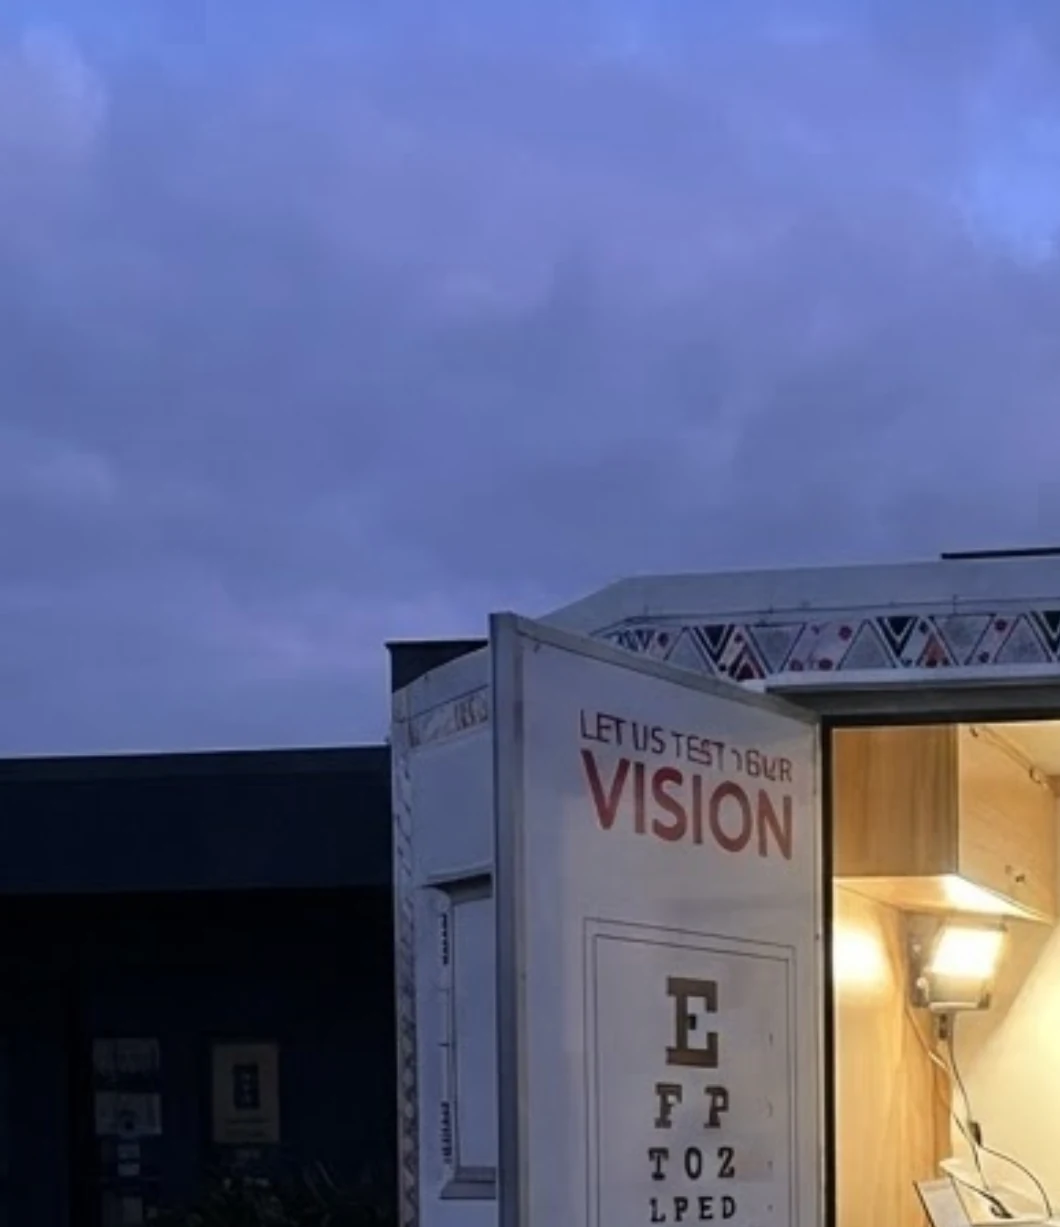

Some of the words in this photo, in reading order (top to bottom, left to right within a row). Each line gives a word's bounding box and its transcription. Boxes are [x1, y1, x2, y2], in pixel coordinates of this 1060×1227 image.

[580, 708, 626, 747] LET
[632, 722, 666, 754] US
[671, 732, 725, 771] TEST
[580, 748, 794, 861] VISION
[665, 976, 718, 1068] E
